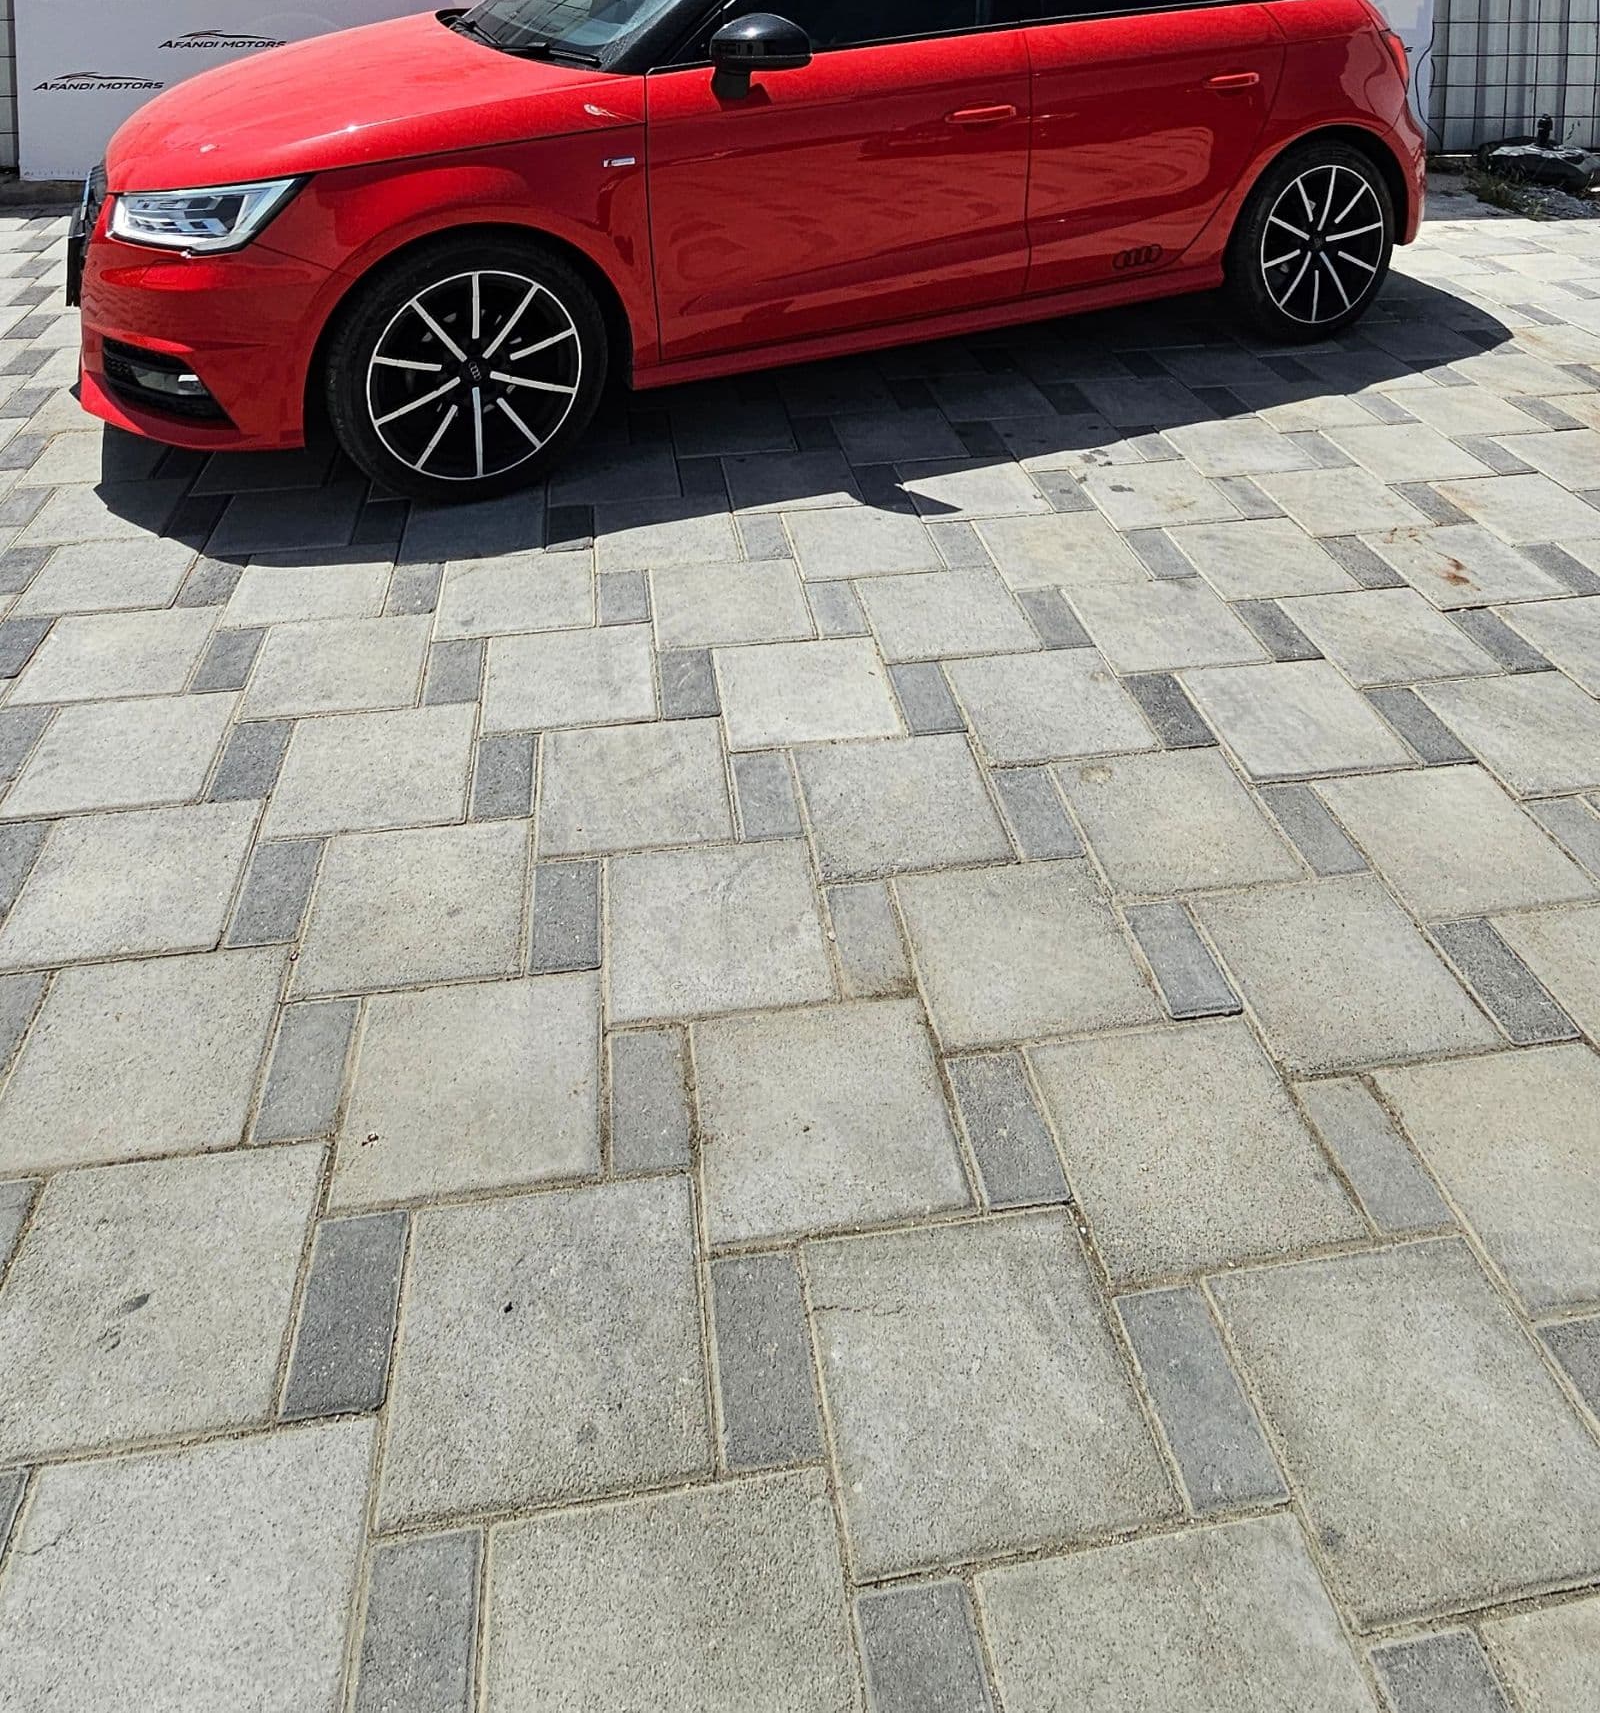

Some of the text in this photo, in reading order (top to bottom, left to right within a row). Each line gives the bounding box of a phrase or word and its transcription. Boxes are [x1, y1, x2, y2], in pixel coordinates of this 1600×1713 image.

[158, 40, 219, 49] AFANDI
[33, 82, 164, 91] AFANDI MOTORS
